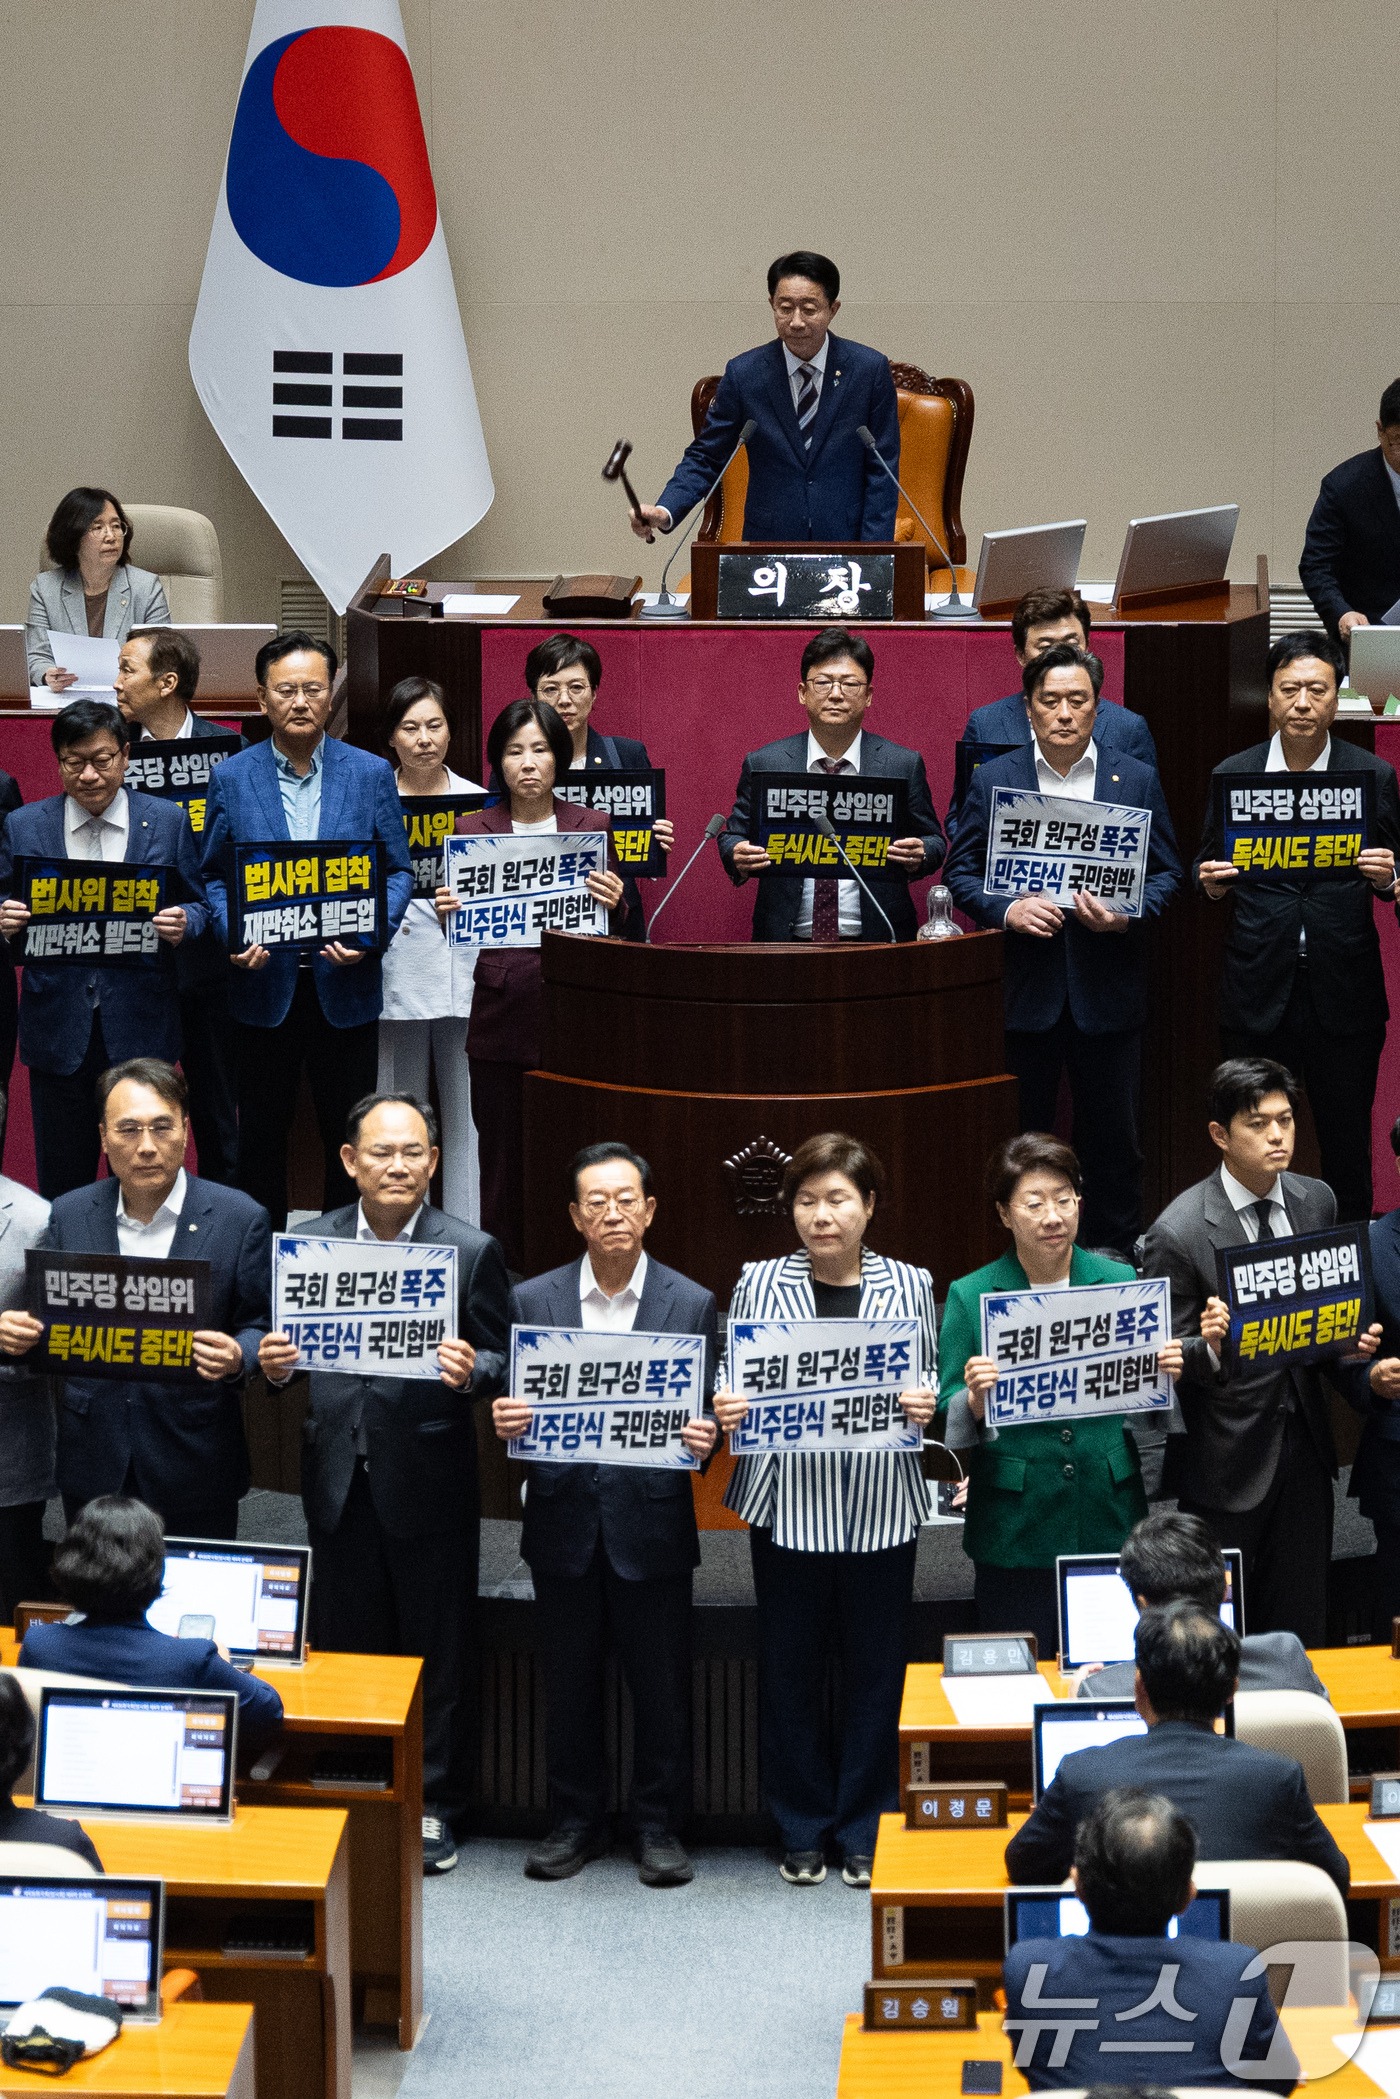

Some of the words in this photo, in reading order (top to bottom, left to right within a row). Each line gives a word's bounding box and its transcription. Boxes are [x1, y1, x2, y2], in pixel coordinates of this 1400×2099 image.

[124, 757, 165, 790] 주당
[592, 785, 652, 816] 상임위
[766, 788, 829, 819] 민주당
[833, 791, 894, 823] 상임위
[1230, 788, 1295, 821] 민주당
[1299, 787, 1362, 820] 상임위
[402, 810, 455, 848] 사위
[1000, 819, 1041, 848] 국회
[1044, 820, 1100, 851] 원구성
[1100, 825, 1142, 858] 폭주
[766, 833, 841, 865] 독식시도
[843, 835, 891, 867] 중단!
[1232, 836, 1310, 871] 독식시도
[1314, 834, 1362, 867] 중단!
[244, 857, 319, 902] 법사위
[325, 855, 371, 893] 집착
[456, 864, 496, 897] 국회
[502, 856, 555, 892] 원구성
[558, 851, 598, 885] 폭주
[993, 859, 1066, 895] 민주당식
[1068, 864, 1136, 899] 국민협박
[31, 877, 106, 915] 법사위
[112, 879, 160, 913] 집착
[243, 904, 318, 945] 재판취소
[321, 898, 375, 937] 빌드업
[455, 903, 527, 943] 민주당식
[532, 892, 598, 930] 국민협박
[24, 921, 101, 957] 재판취소
[104, 920, 159, 954] 빌드업
[45, 1270, 118, 1309] 민주당
[122, 1275, 195, 1314] 상임위
[285, 1272, 328, 1309] 국회
[335, 1270, 398, 1307] 원구성
[400, 1268, 446, 1308] 폭주
[1233, 1256, 1296, 1304] 민주당
[1300, 1244, 1360, 1291] 상임위
[48, 1324, 136, 1363] 독식시도
[140, 1328, 194, 1367] 중단!
[368, 1319, 446, 1359] 국민협박
[997, 1325, 1042, 1365] 국회
[1050, 1312, 1111, 1357] 원구성
[1115, 1301, 1159, 1346] 폭주
[1239, 1309, 1313, 1360] 독식시도
[1316, 1298, 1361, 1345] 중단!
[523, 1363, 571, 1400] 국회
[577, 1360, 643, 1397] 원구성
[645, 1358, 693, 1398] 폭주
[743, 1354, 789, 1393] 국회
[796, 1346, 860, 1388] 원구성
[864, 1340, 911, 1382] 폭주
[996, 1367, 1078, 1418] 민주당식
[1084, 1352, 1159, 1400] 국민협박
[740, 1400, 825, 1447] 민주당식
